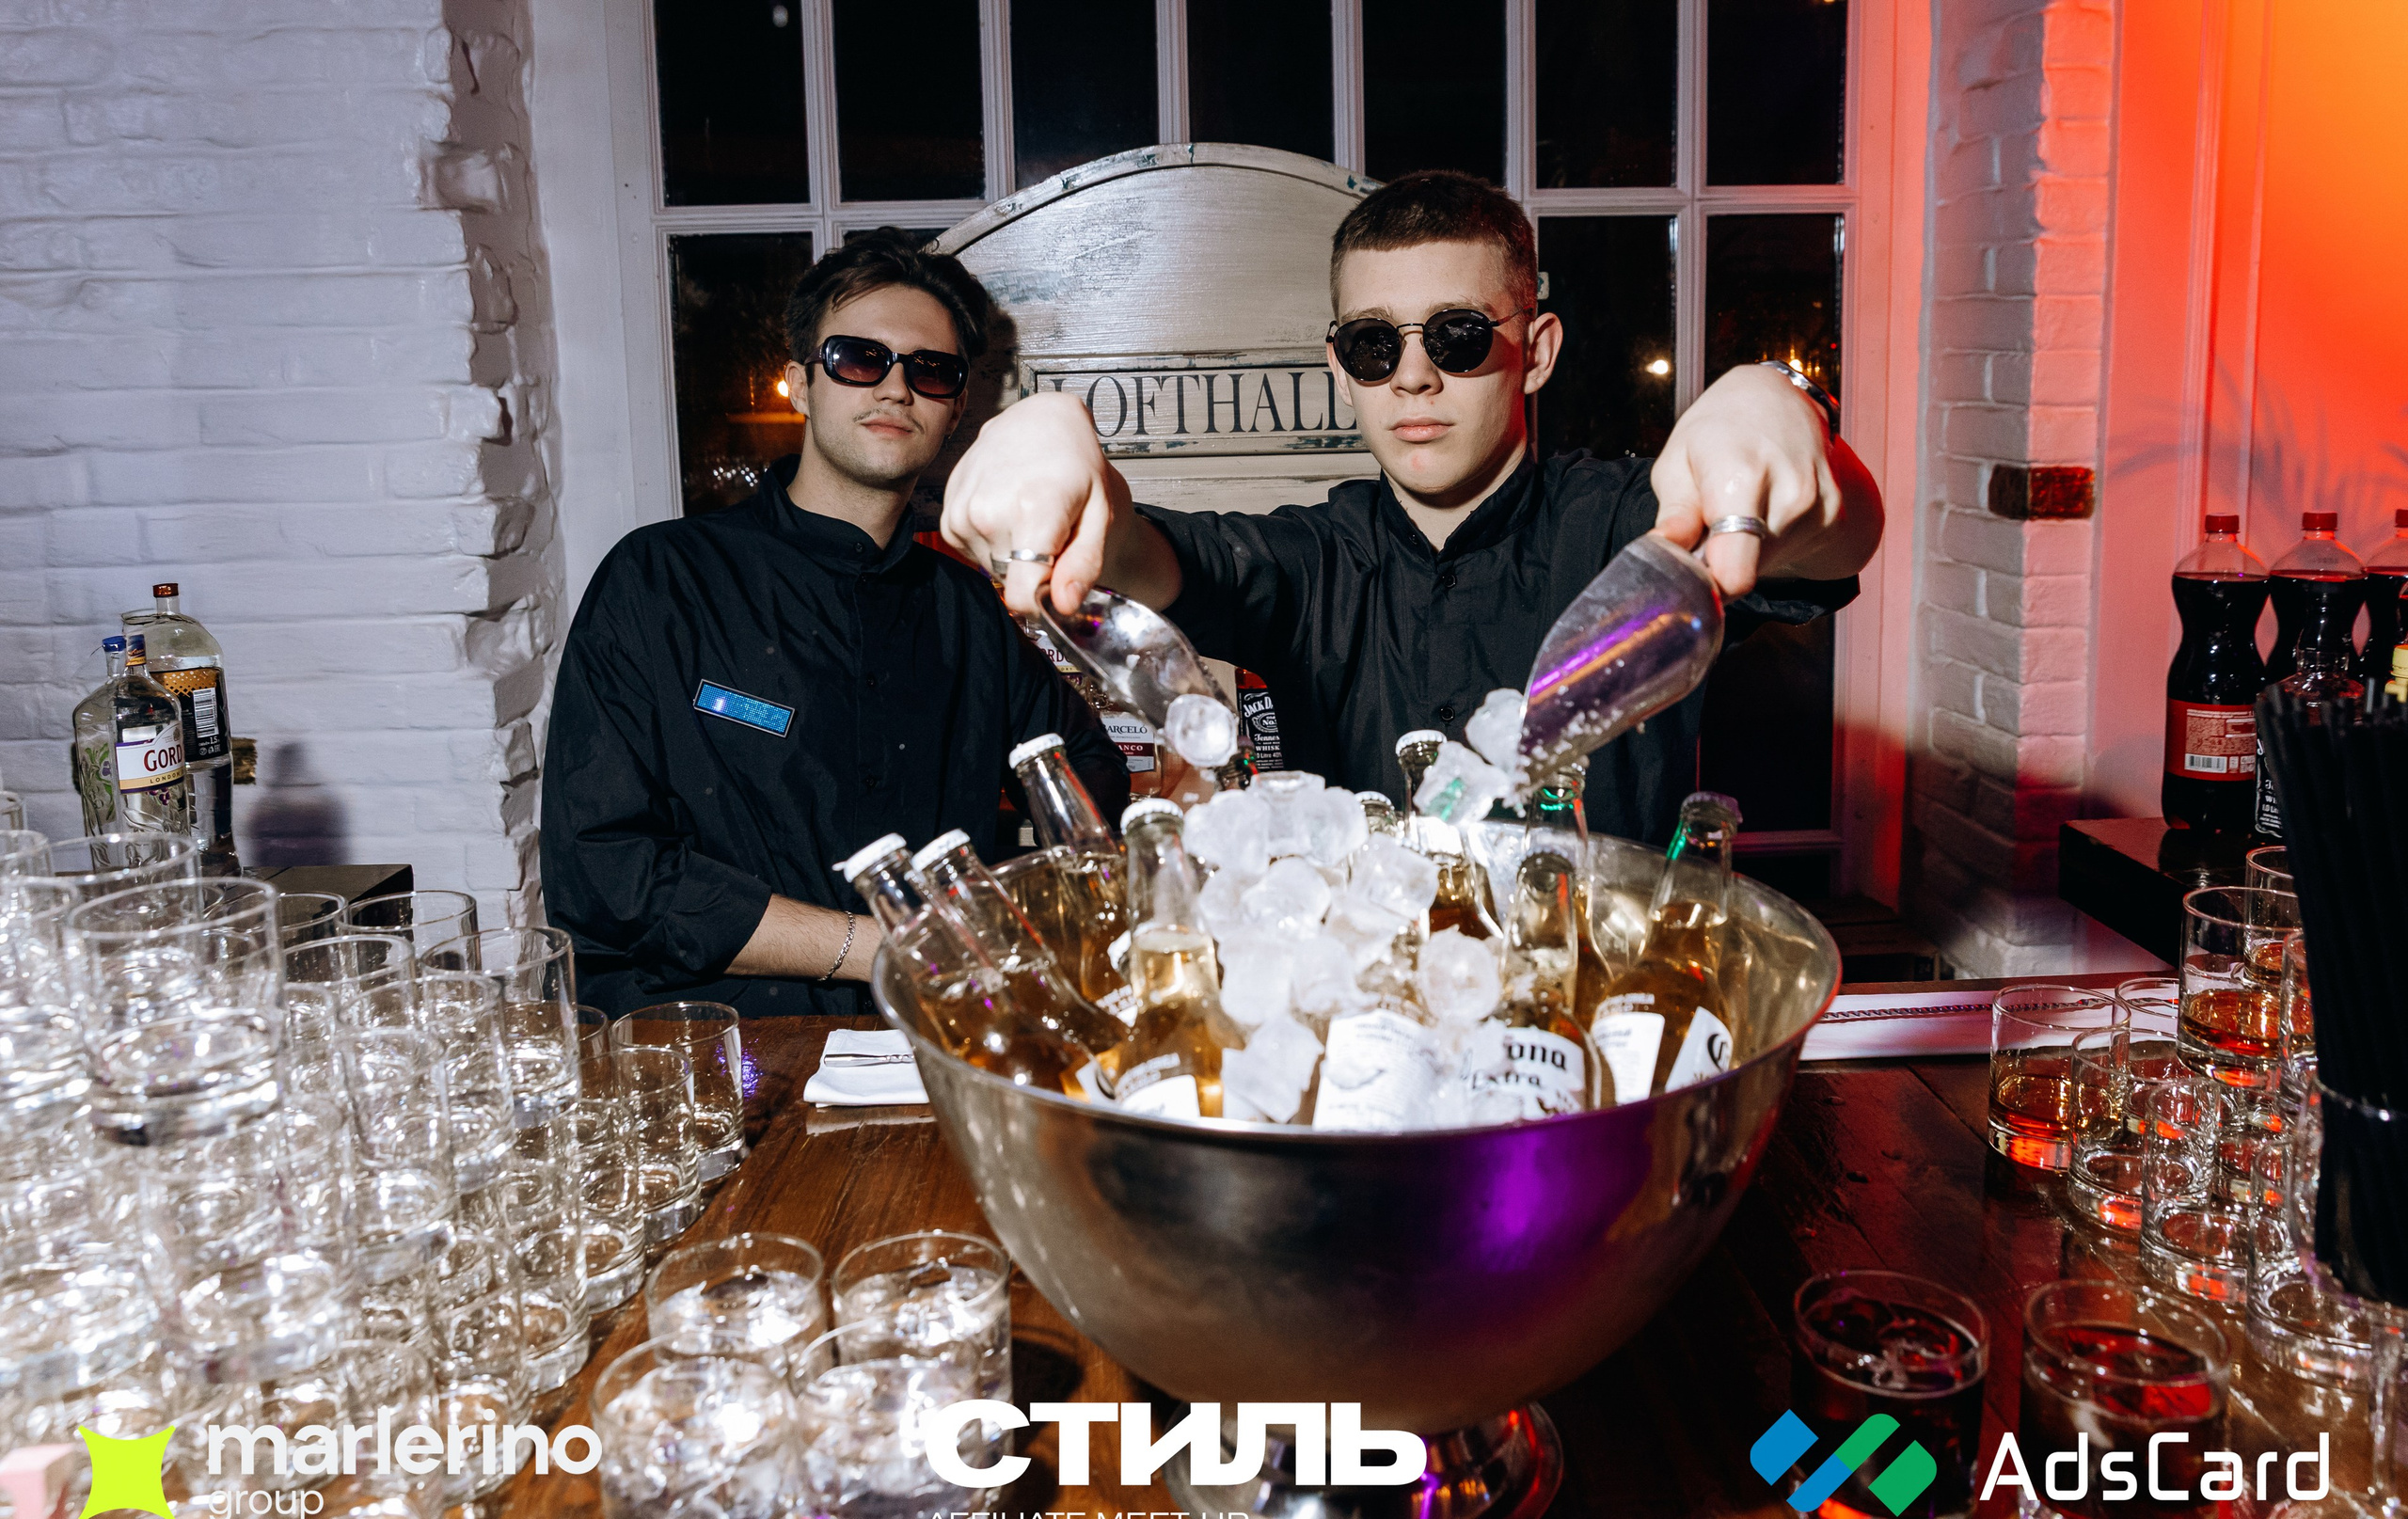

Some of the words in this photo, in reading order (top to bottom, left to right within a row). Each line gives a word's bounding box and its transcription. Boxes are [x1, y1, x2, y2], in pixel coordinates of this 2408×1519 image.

[1050, 371, 1357, 438] OFTHALL
[1243, 700, 1265, 718] JACK
[1264, 696, 1274, 710] D
[143, 744, 182, 772] GORD
[1505, 1042, 1567, 1071] ona
